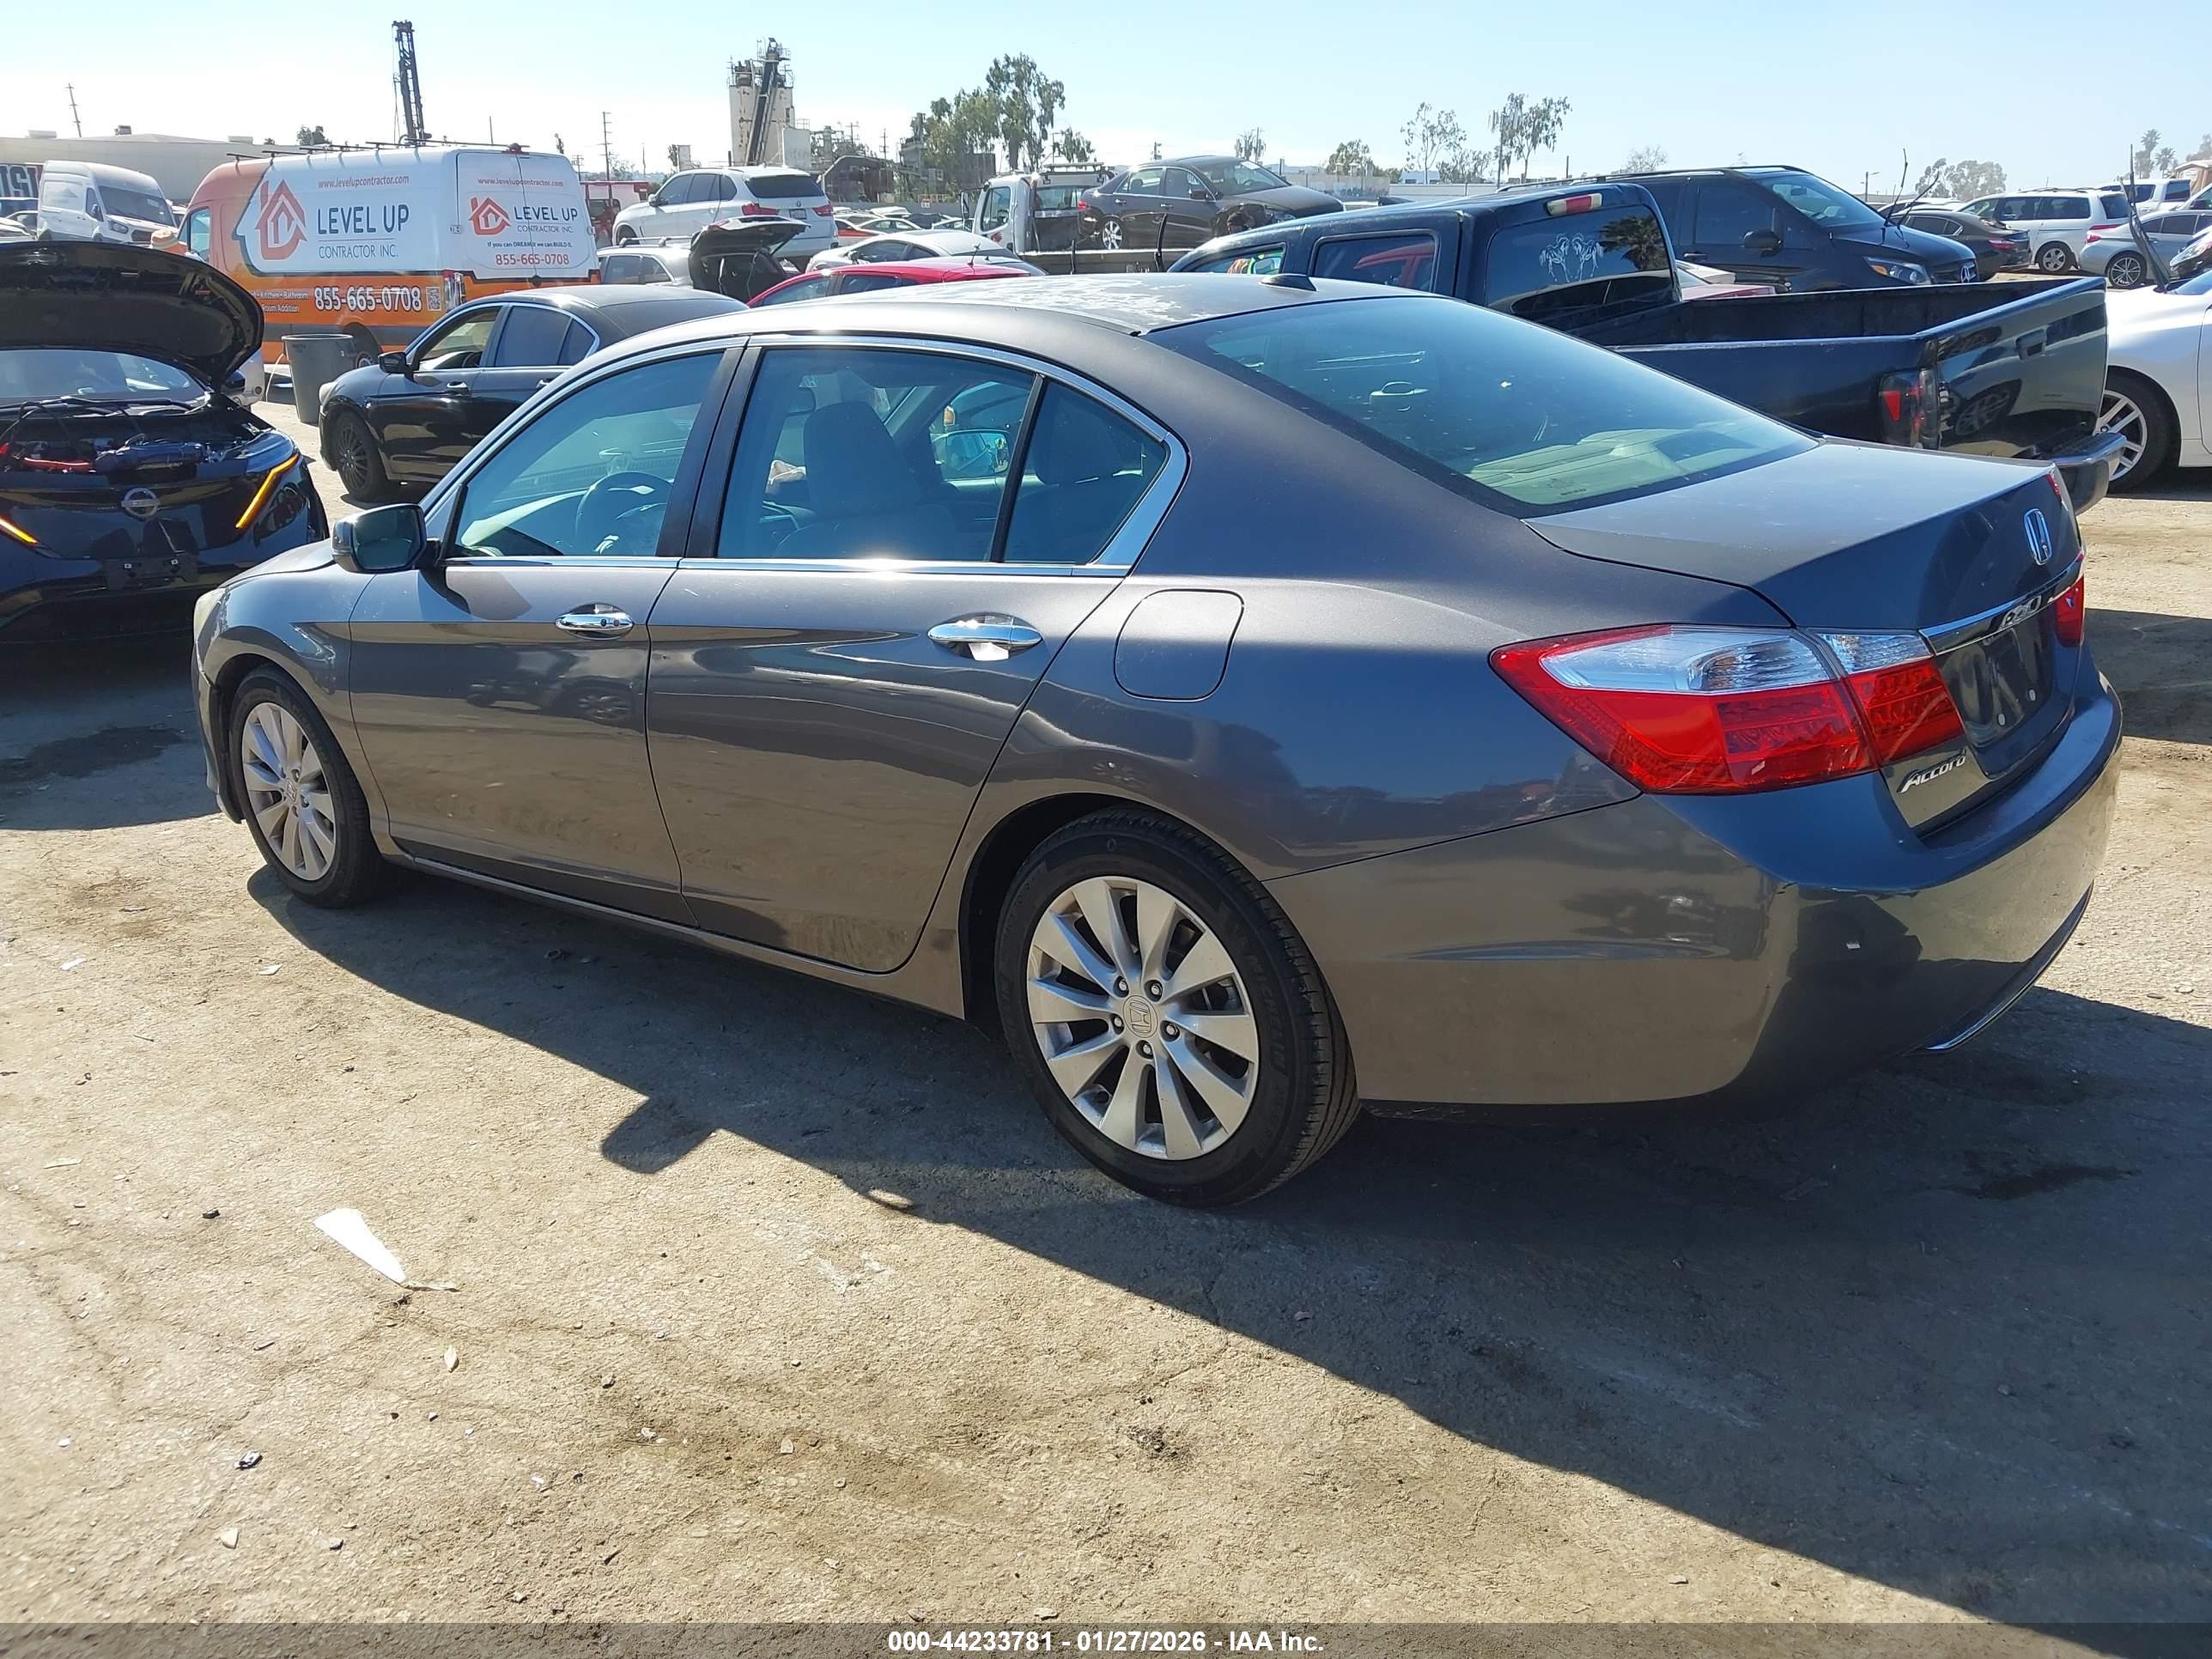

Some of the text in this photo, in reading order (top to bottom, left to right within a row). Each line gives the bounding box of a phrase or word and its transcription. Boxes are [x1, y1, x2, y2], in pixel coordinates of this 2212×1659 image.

[318, 175, 410, 189] www.levelupcontractor.com
[477, 178, 564, 187] www.levelupcontractor.com
[318, 204, 410, 234] LEVEL UP
[514, 206, 578, 221] LEVEL UP
[517, 225, 560, 234] CONTRACTOR
[319, 244, 398, 258] CONTRACTOR INC.
[495, 253, 569, 265] 855-665-0708
[283, 291, 308, 300] Bathroom
[314, 286, 422, 312] 855-665-0708
